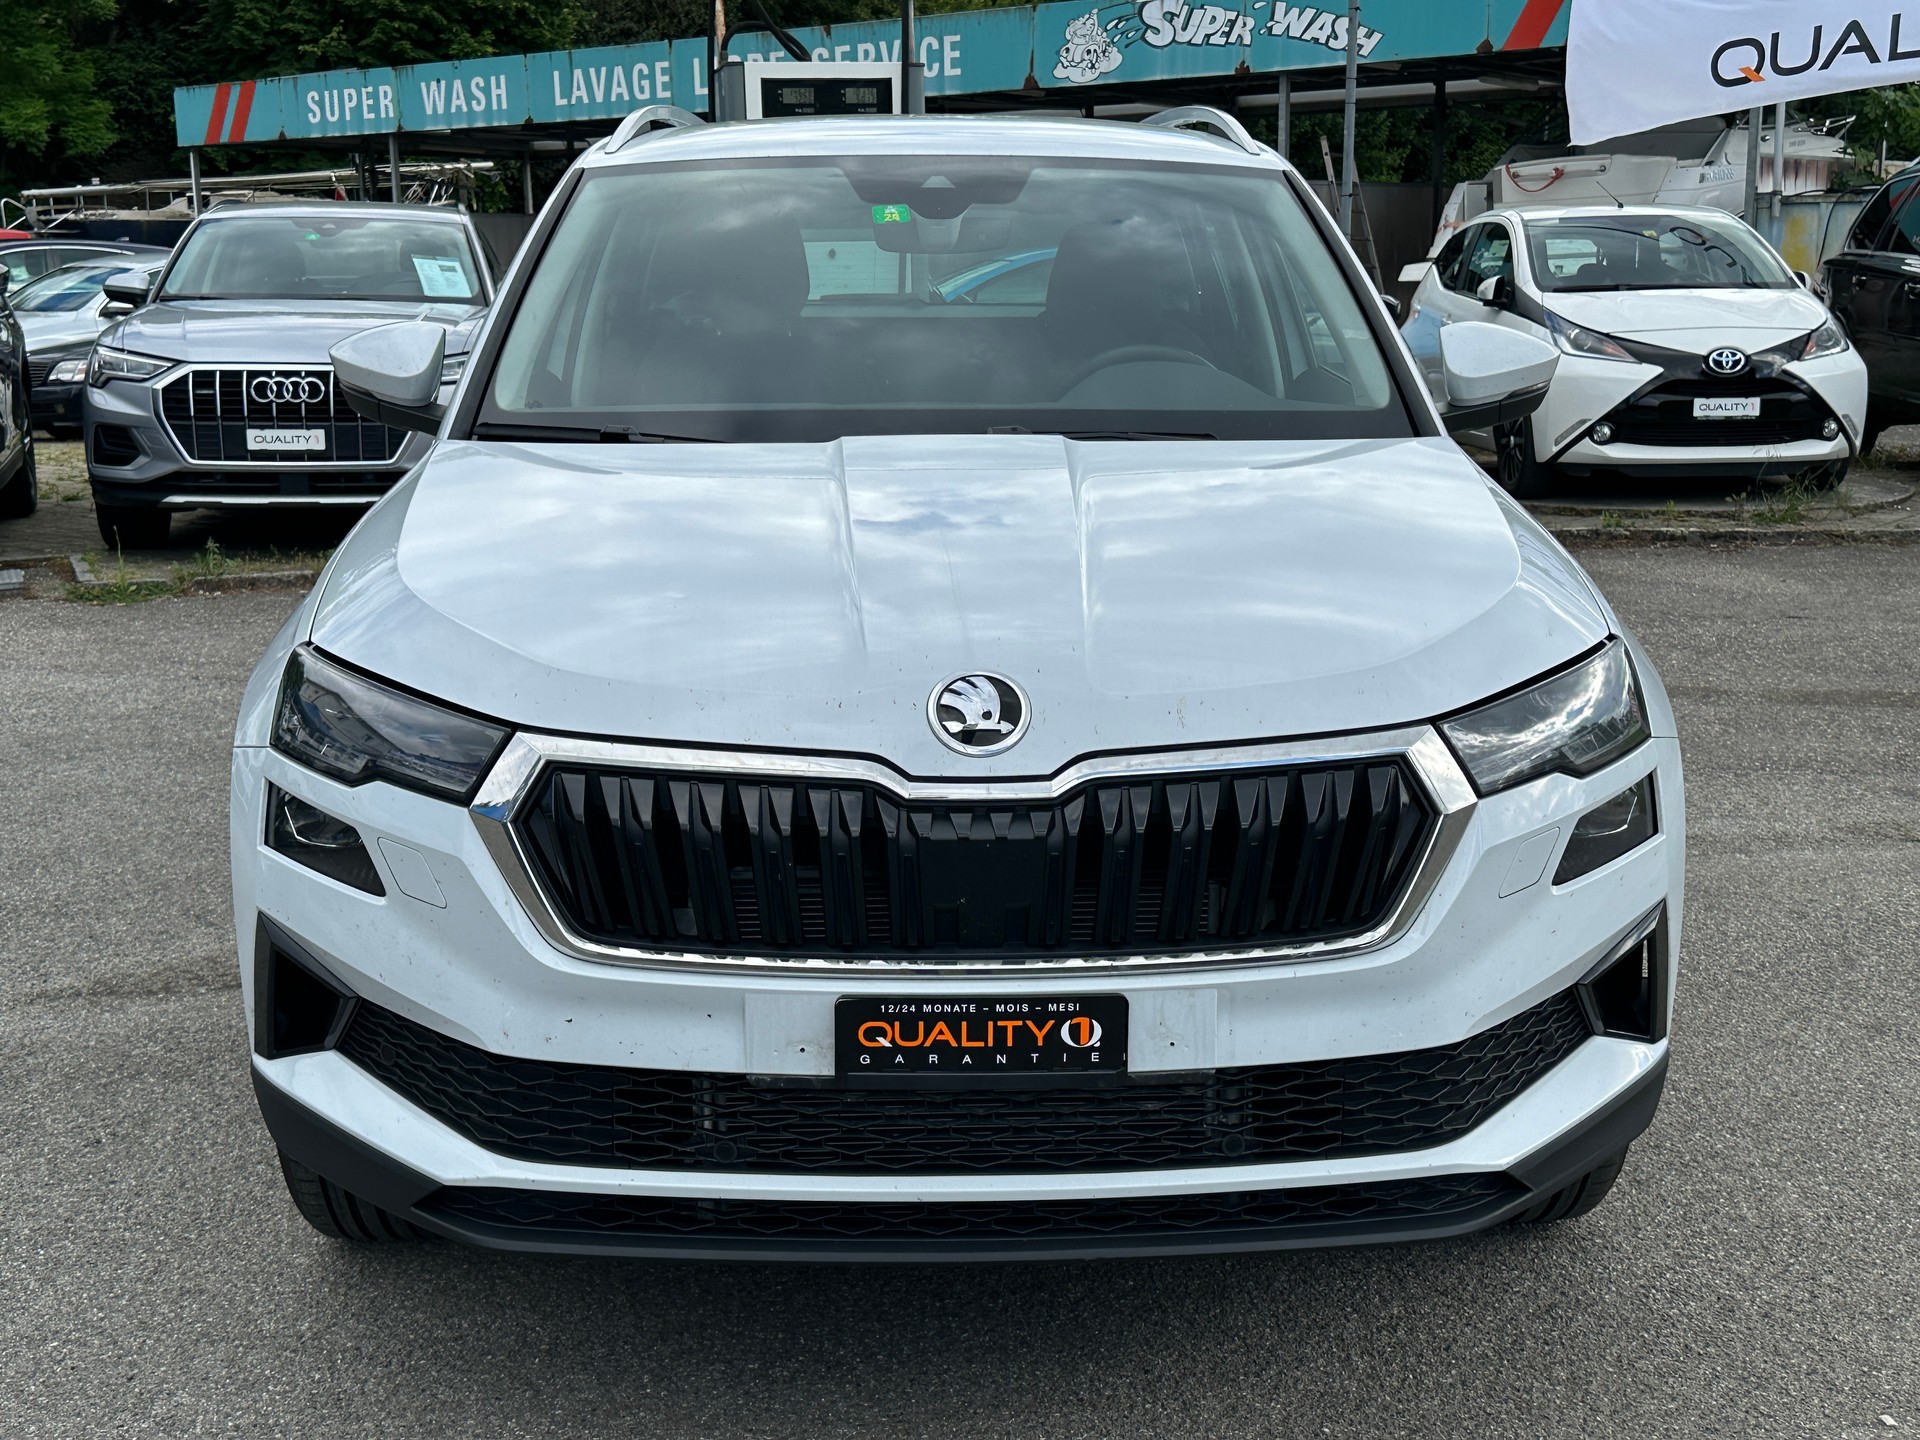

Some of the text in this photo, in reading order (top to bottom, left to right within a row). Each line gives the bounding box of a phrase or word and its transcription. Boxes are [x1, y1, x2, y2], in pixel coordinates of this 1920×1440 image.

[1139, 0, 1384, 58] SUPER WASH
[1710, 13, 1920, 88] QUAL
[307, 85, 395, 124] SUPER
[420, 75, 508, 115] WASH
[553, 61, 672, 106] LAVAGE
[1699, 402, 1748, 411] QUALITY
[880, 1004, 917, 1014] 12/24
[922, 1004, 977, 1013] MONATE
[995, 1004, 1029, 1013] MOIS
[1048, 1003, 1080, 1012] MESI
[857, 1019, 1056, 1048] QUALITY
[859, 1052, 1101, 1065] GARANTIE
